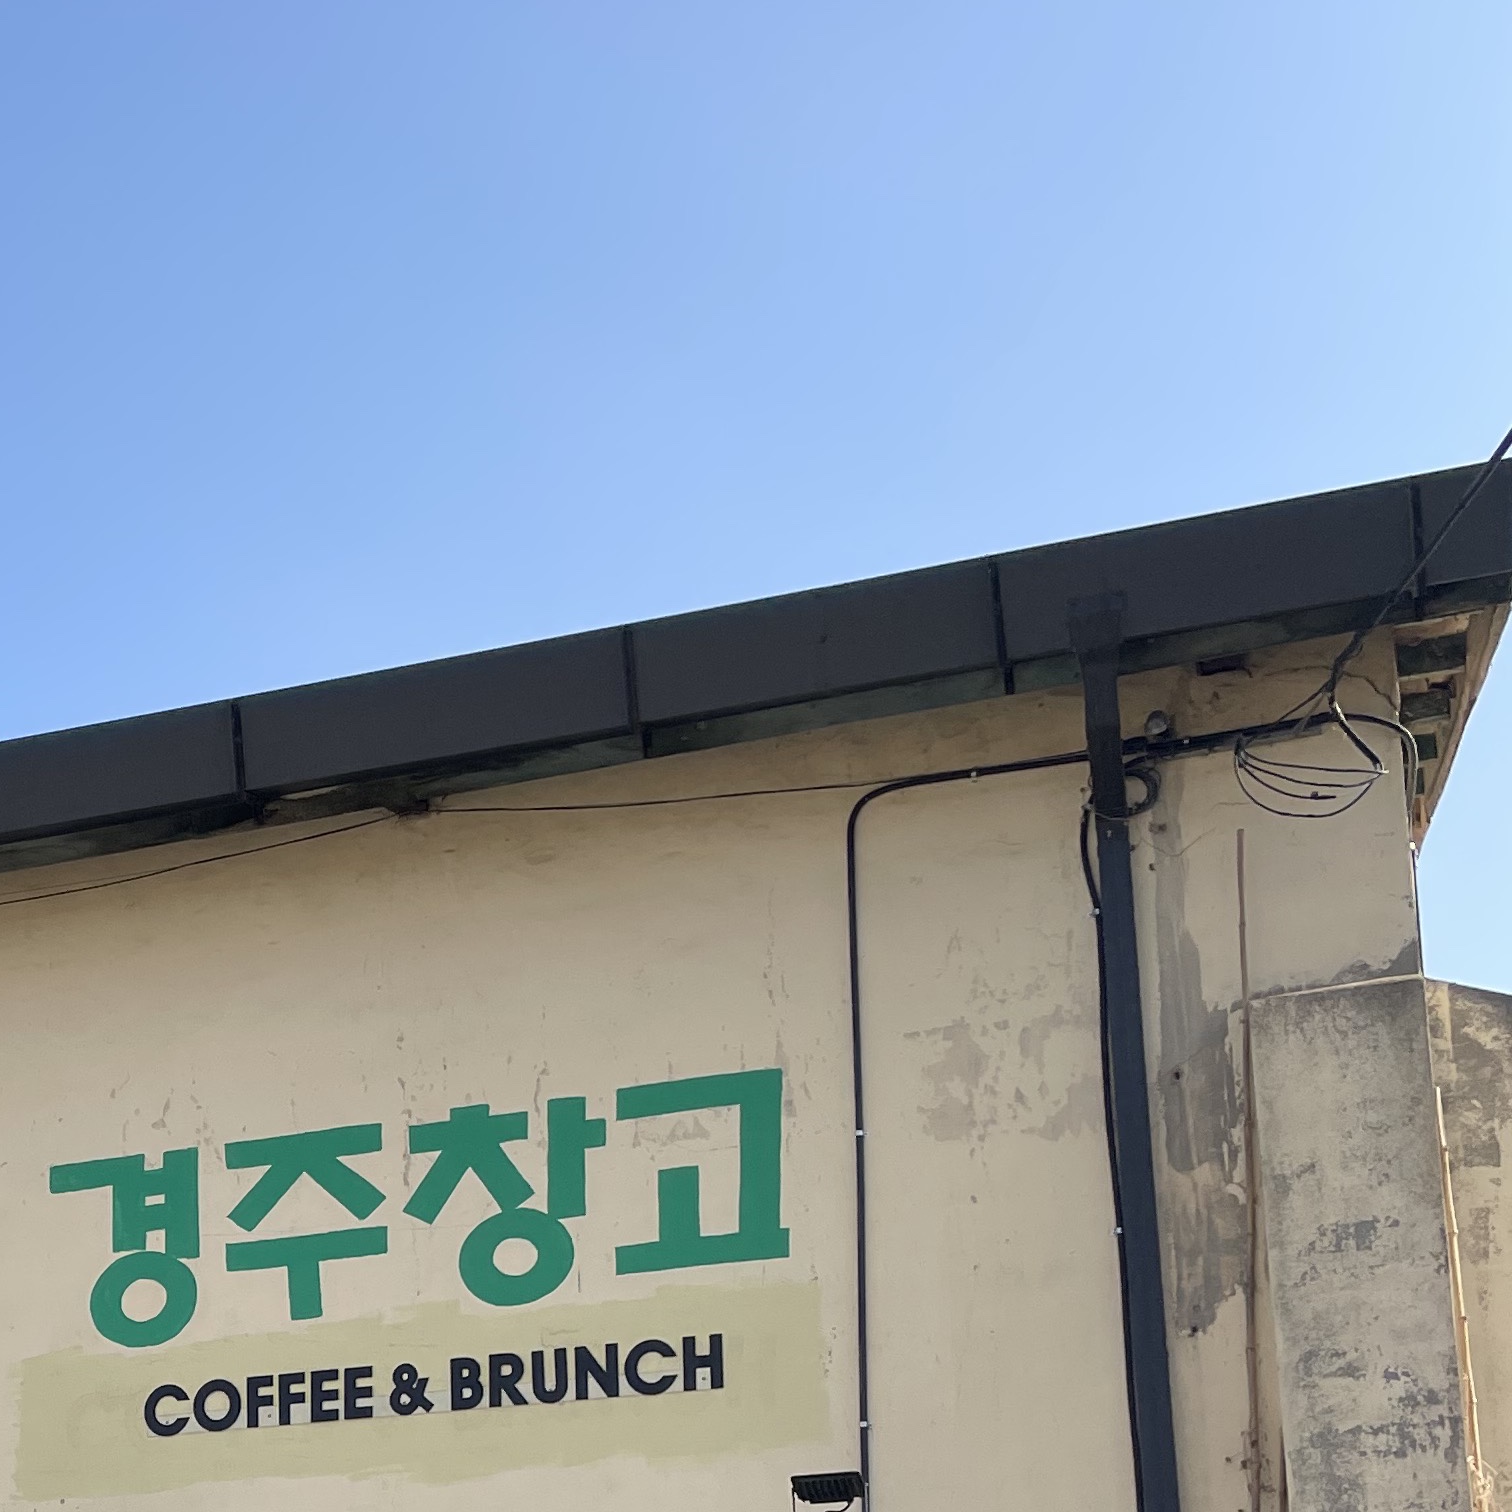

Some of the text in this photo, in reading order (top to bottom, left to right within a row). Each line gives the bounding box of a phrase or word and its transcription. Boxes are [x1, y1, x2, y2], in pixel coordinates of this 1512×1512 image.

[49, 1068, 790, 1348] 경주창고
[143, 1333, 725, 1437] COFFEE & BRUNCH
